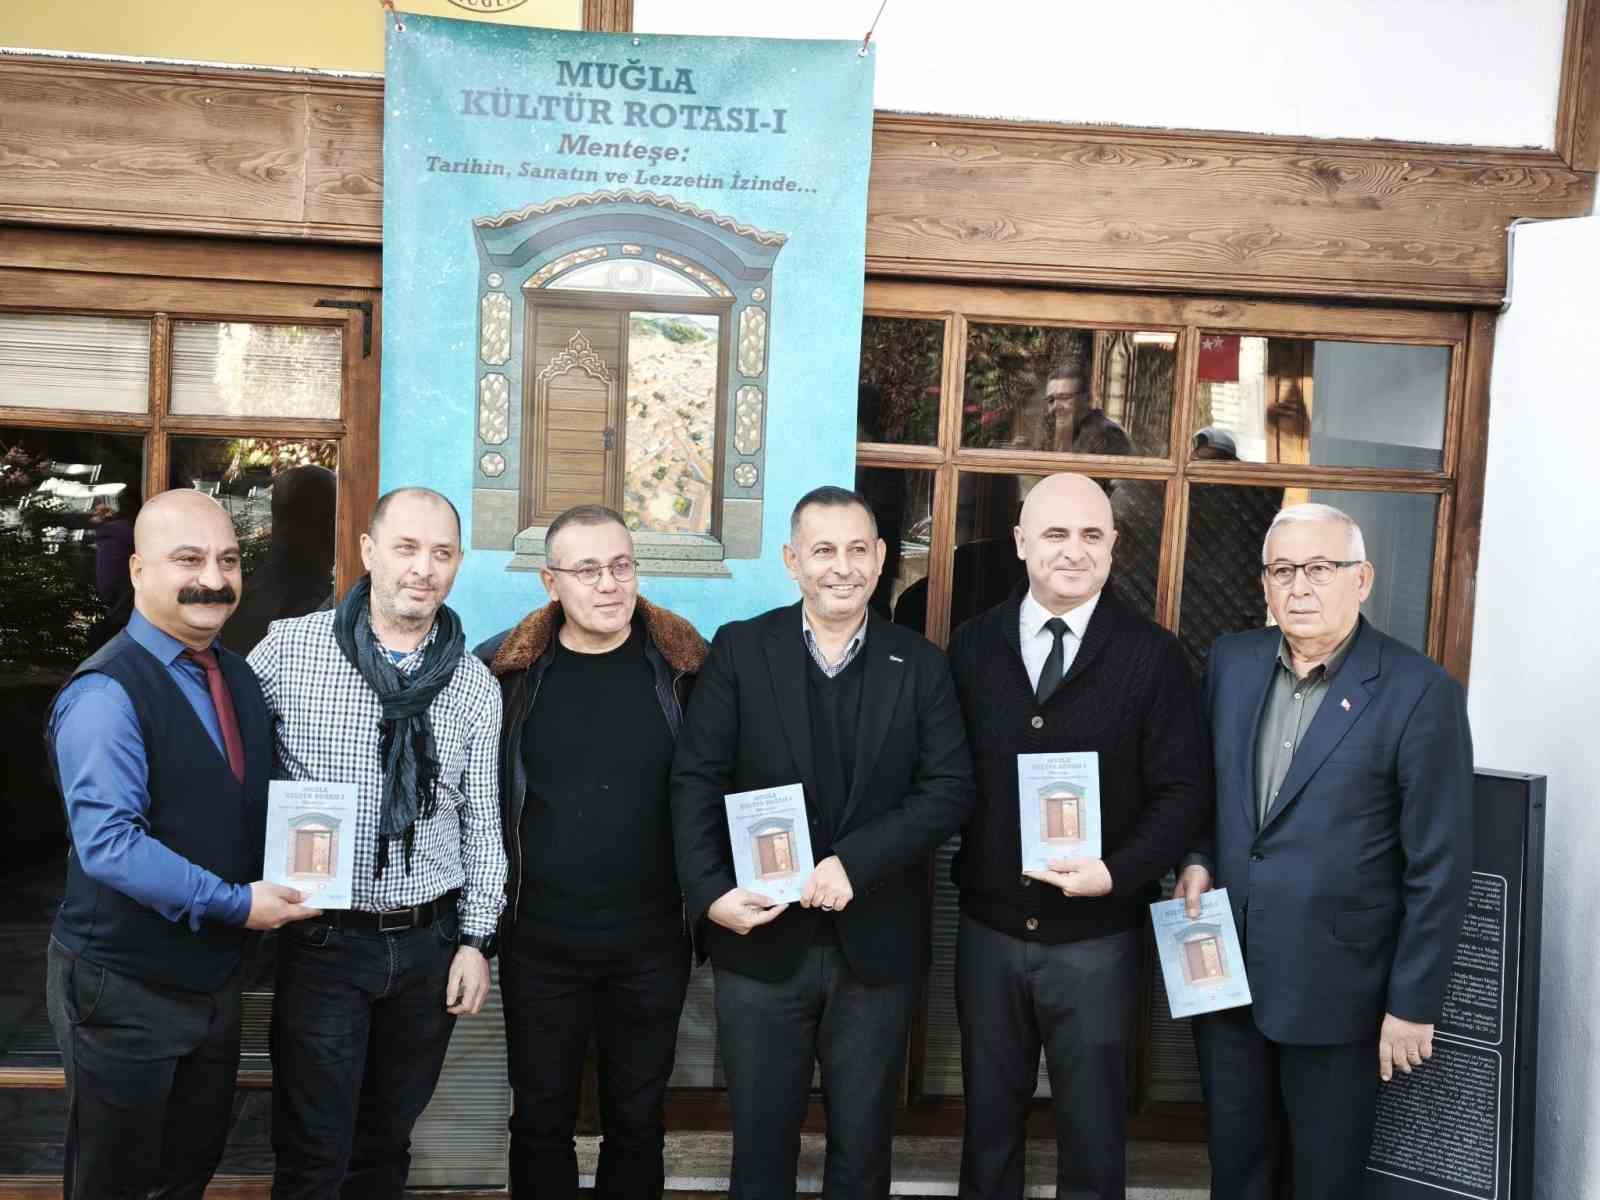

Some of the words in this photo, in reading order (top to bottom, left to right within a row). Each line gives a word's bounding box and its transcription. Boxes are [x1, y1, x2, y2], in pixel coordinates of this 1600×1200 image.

[556, 58, 697, 95] MUĞLA
[460, 86, 612, 126] KÜLTÜR
[623, 101, 788, 134] ROTASI-I
[557, 133, 690, 167] Menteşe:
[426, 156, 512, 178] Tarihin,
[517, 161, 598, 183] Sanatın
[605, 171, 629, 184] ve
[634, 169, 724, 189] Lezzetin
[729, 170, 818, 194] İzinde...
